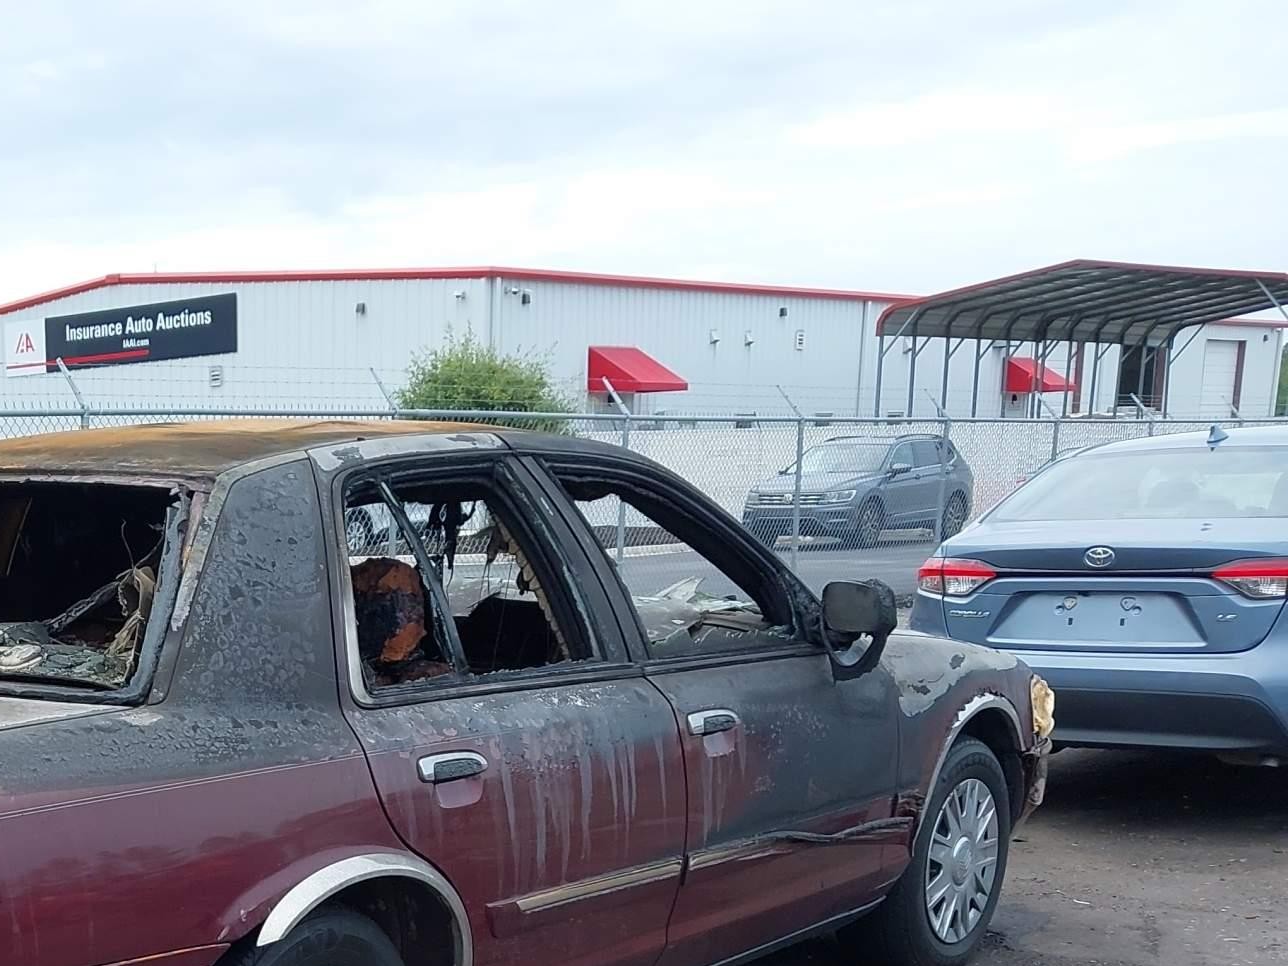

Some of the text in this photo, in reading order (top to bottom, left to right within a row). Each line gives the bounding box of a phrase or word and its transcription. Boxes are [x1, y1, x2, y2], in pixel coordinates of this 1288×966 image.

[65, 309, 212, 342] Insurance Auto Auctions
